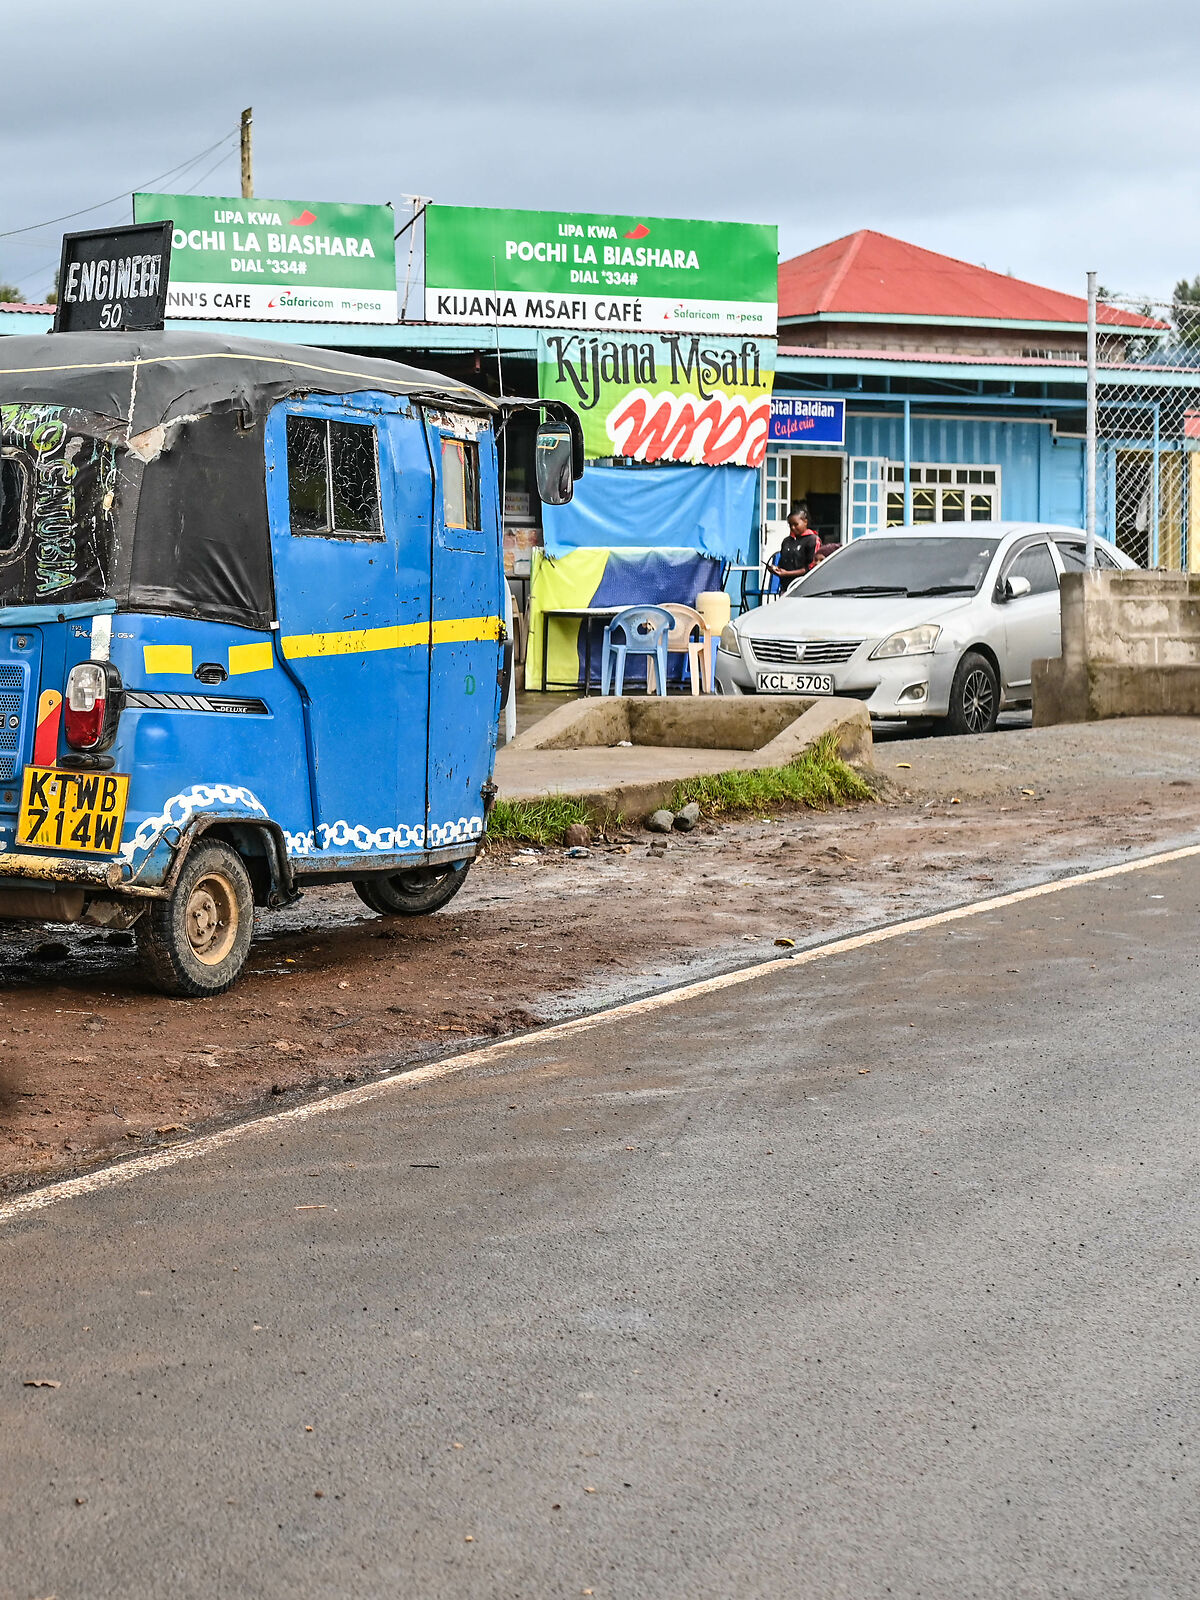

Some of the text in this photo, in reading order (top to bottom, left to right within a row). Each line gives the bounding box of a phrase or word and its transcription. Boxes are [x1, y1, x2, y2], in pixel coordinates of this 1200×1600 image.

[214, 210, 282, 226] LIPA KWA
[558, 224, 618, 239] LIPA KWA
[171, 229, 375, 258] OCHI LA BIASHARA
[505, 241, 700, 270] POCHI LA BIASHARA
[230, 258, 264, 273] DIAL
[64, 254, 162, 303] ENGINEER
[570, 270, 599, 284] DIAL
[166, 293, 251, 308] NN'S CAFE
[280, 296, 333, 308] Safaricom
[437, 296, 642, 322] KIJANA MSAFI CAFÉ
[100, 304, 123, 329] 50
[673, 309, 720, 320] Safaricom
[547, 335, 657, 410] Kijana
[795, 401, 835, 418] Baldian
[760, 674, 830, 691] KCL 570S
[28, 771, 118, 812] KTWB
[25, 808, 118, 850] 714W
